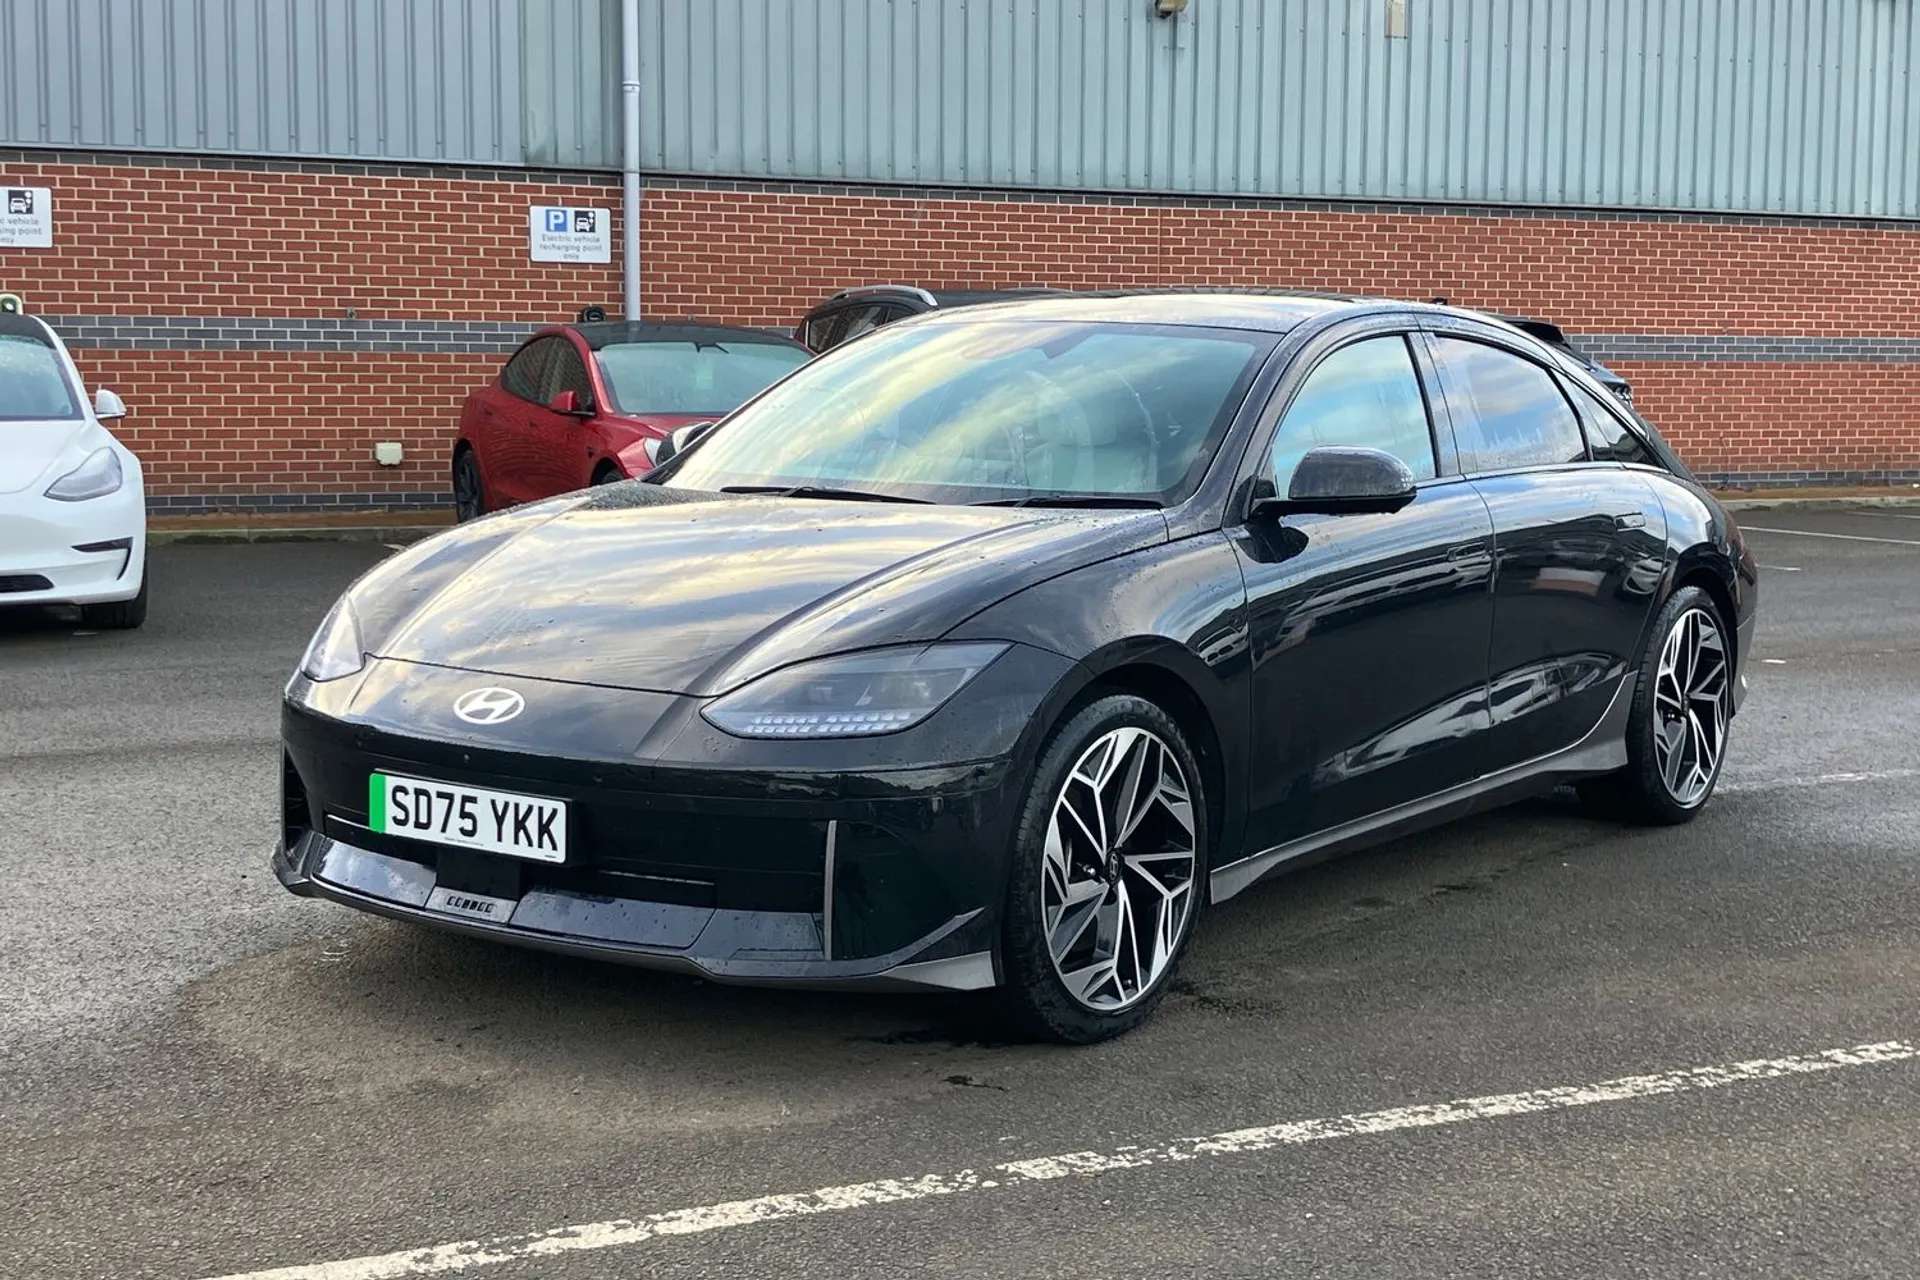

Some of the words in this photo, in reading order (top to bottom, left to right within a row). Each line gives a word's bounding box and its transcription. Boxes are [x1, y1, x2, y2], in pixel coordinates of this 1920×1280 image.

[7, 217, 39, 225] vehicle
[549, 211, 564, 231] P
[18, 227, 43, 235] point
[542, 233, 572, 242] Electric
[574, 234, 601, 243] vehicle
[539, 243, 581, 252] recharging
[582, 244, 603, 252] point
[391, 784, 479, 838] SD75
[490, 798, 559, 851] YKK
